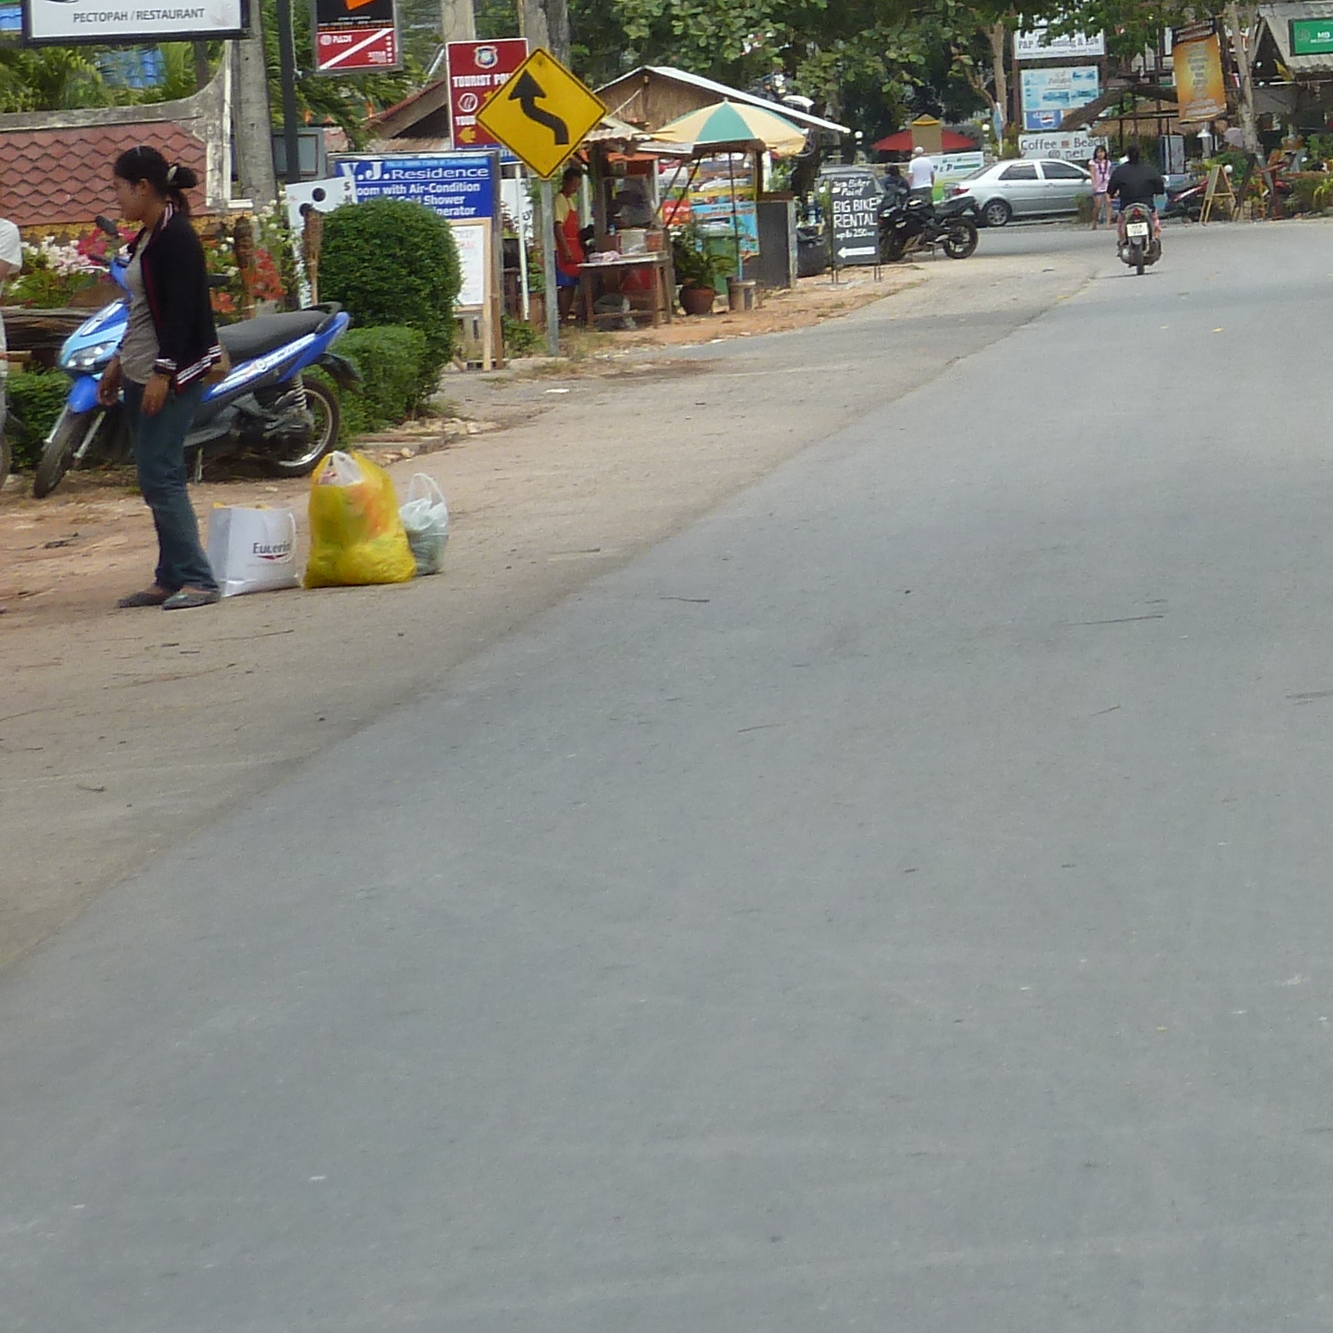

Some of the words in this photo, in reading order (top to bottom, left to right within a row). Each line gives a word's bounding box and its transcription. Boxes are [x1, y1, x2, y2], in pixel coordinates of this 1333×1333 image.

[136, 8, 205, 21] RESTAURANT
[1021, 138, 1057, 151] Coffee
[391, 168, 490, 180] Residence
[357, 186, 380, 196] oom
[383, 183, 407, 195] with
[409, 181, 481, 194] Air-Condition
[423, 195, 466, 206] Shower
[833, 200, 851, 214] BIG
[852, 197, 877, 212] BIKE
[833, 212, 878, 228] RENTAL
